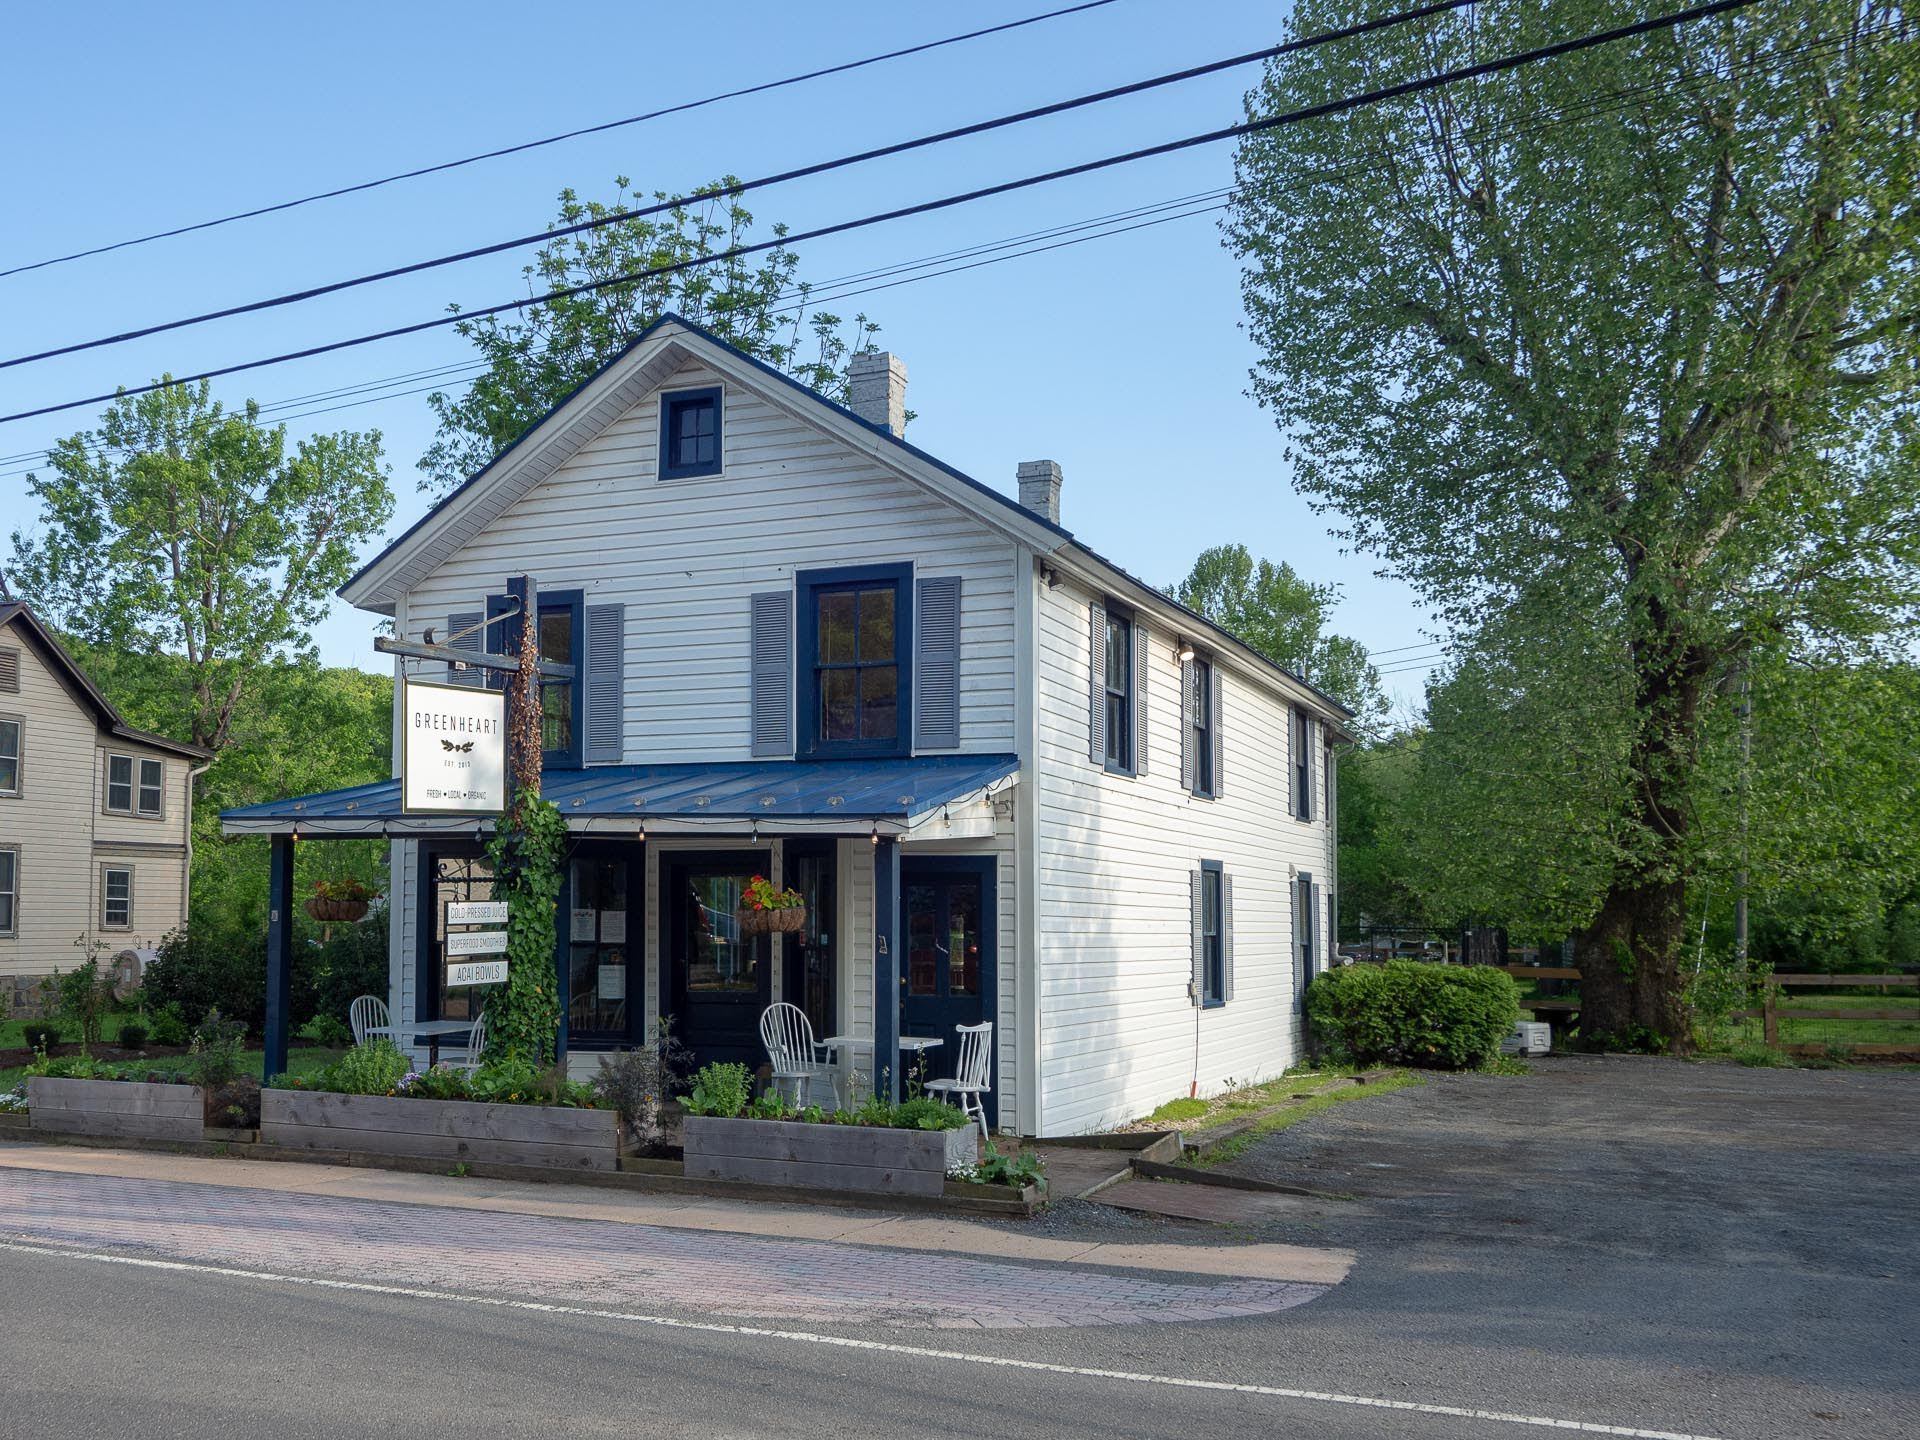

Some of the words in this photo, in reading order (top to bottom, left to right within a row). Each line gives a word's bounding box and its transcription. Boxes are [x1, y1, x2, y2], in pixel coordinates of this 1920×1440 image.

[415, 712, 497, 734] GREENHEART
[426, 789, 442, 799] FRESH
[448, 790, 461, 799] LOCAL
[467, 790, 486, 800] ORGANIC
[491, 905, 506, 918] JUICE
[450, 938, 479, 950] SUPERFOOD
[479, 936, 506, 948] SMOOTHIES
[456, 966, 474, 982] ACAI
[475, 965, 500, 981] BOWLS
